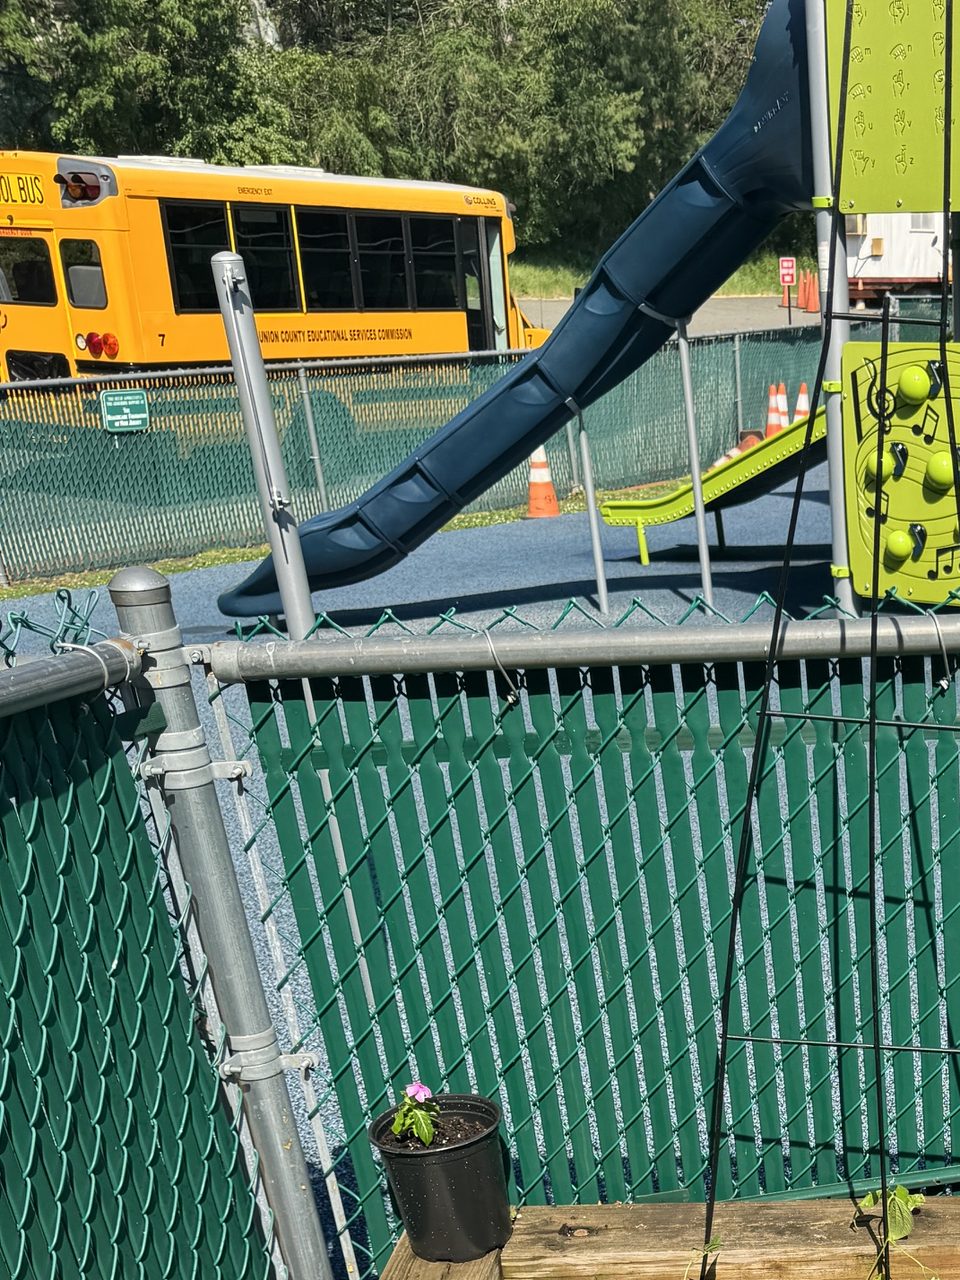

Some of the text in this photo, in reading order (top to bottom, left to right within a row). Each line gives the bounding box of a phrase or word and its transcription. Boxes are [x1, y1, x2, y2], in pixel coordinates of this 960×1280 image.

[17, 176, 44, 204] BUS
[473, 196, 497, 205] COLLINS
[158, 334, 165, 346] 7
[259, 328, 412, 343] UNION COUNTY EDUCATIONAL SERVICES COMMISSION
[527, 334, 533, 345] 7
